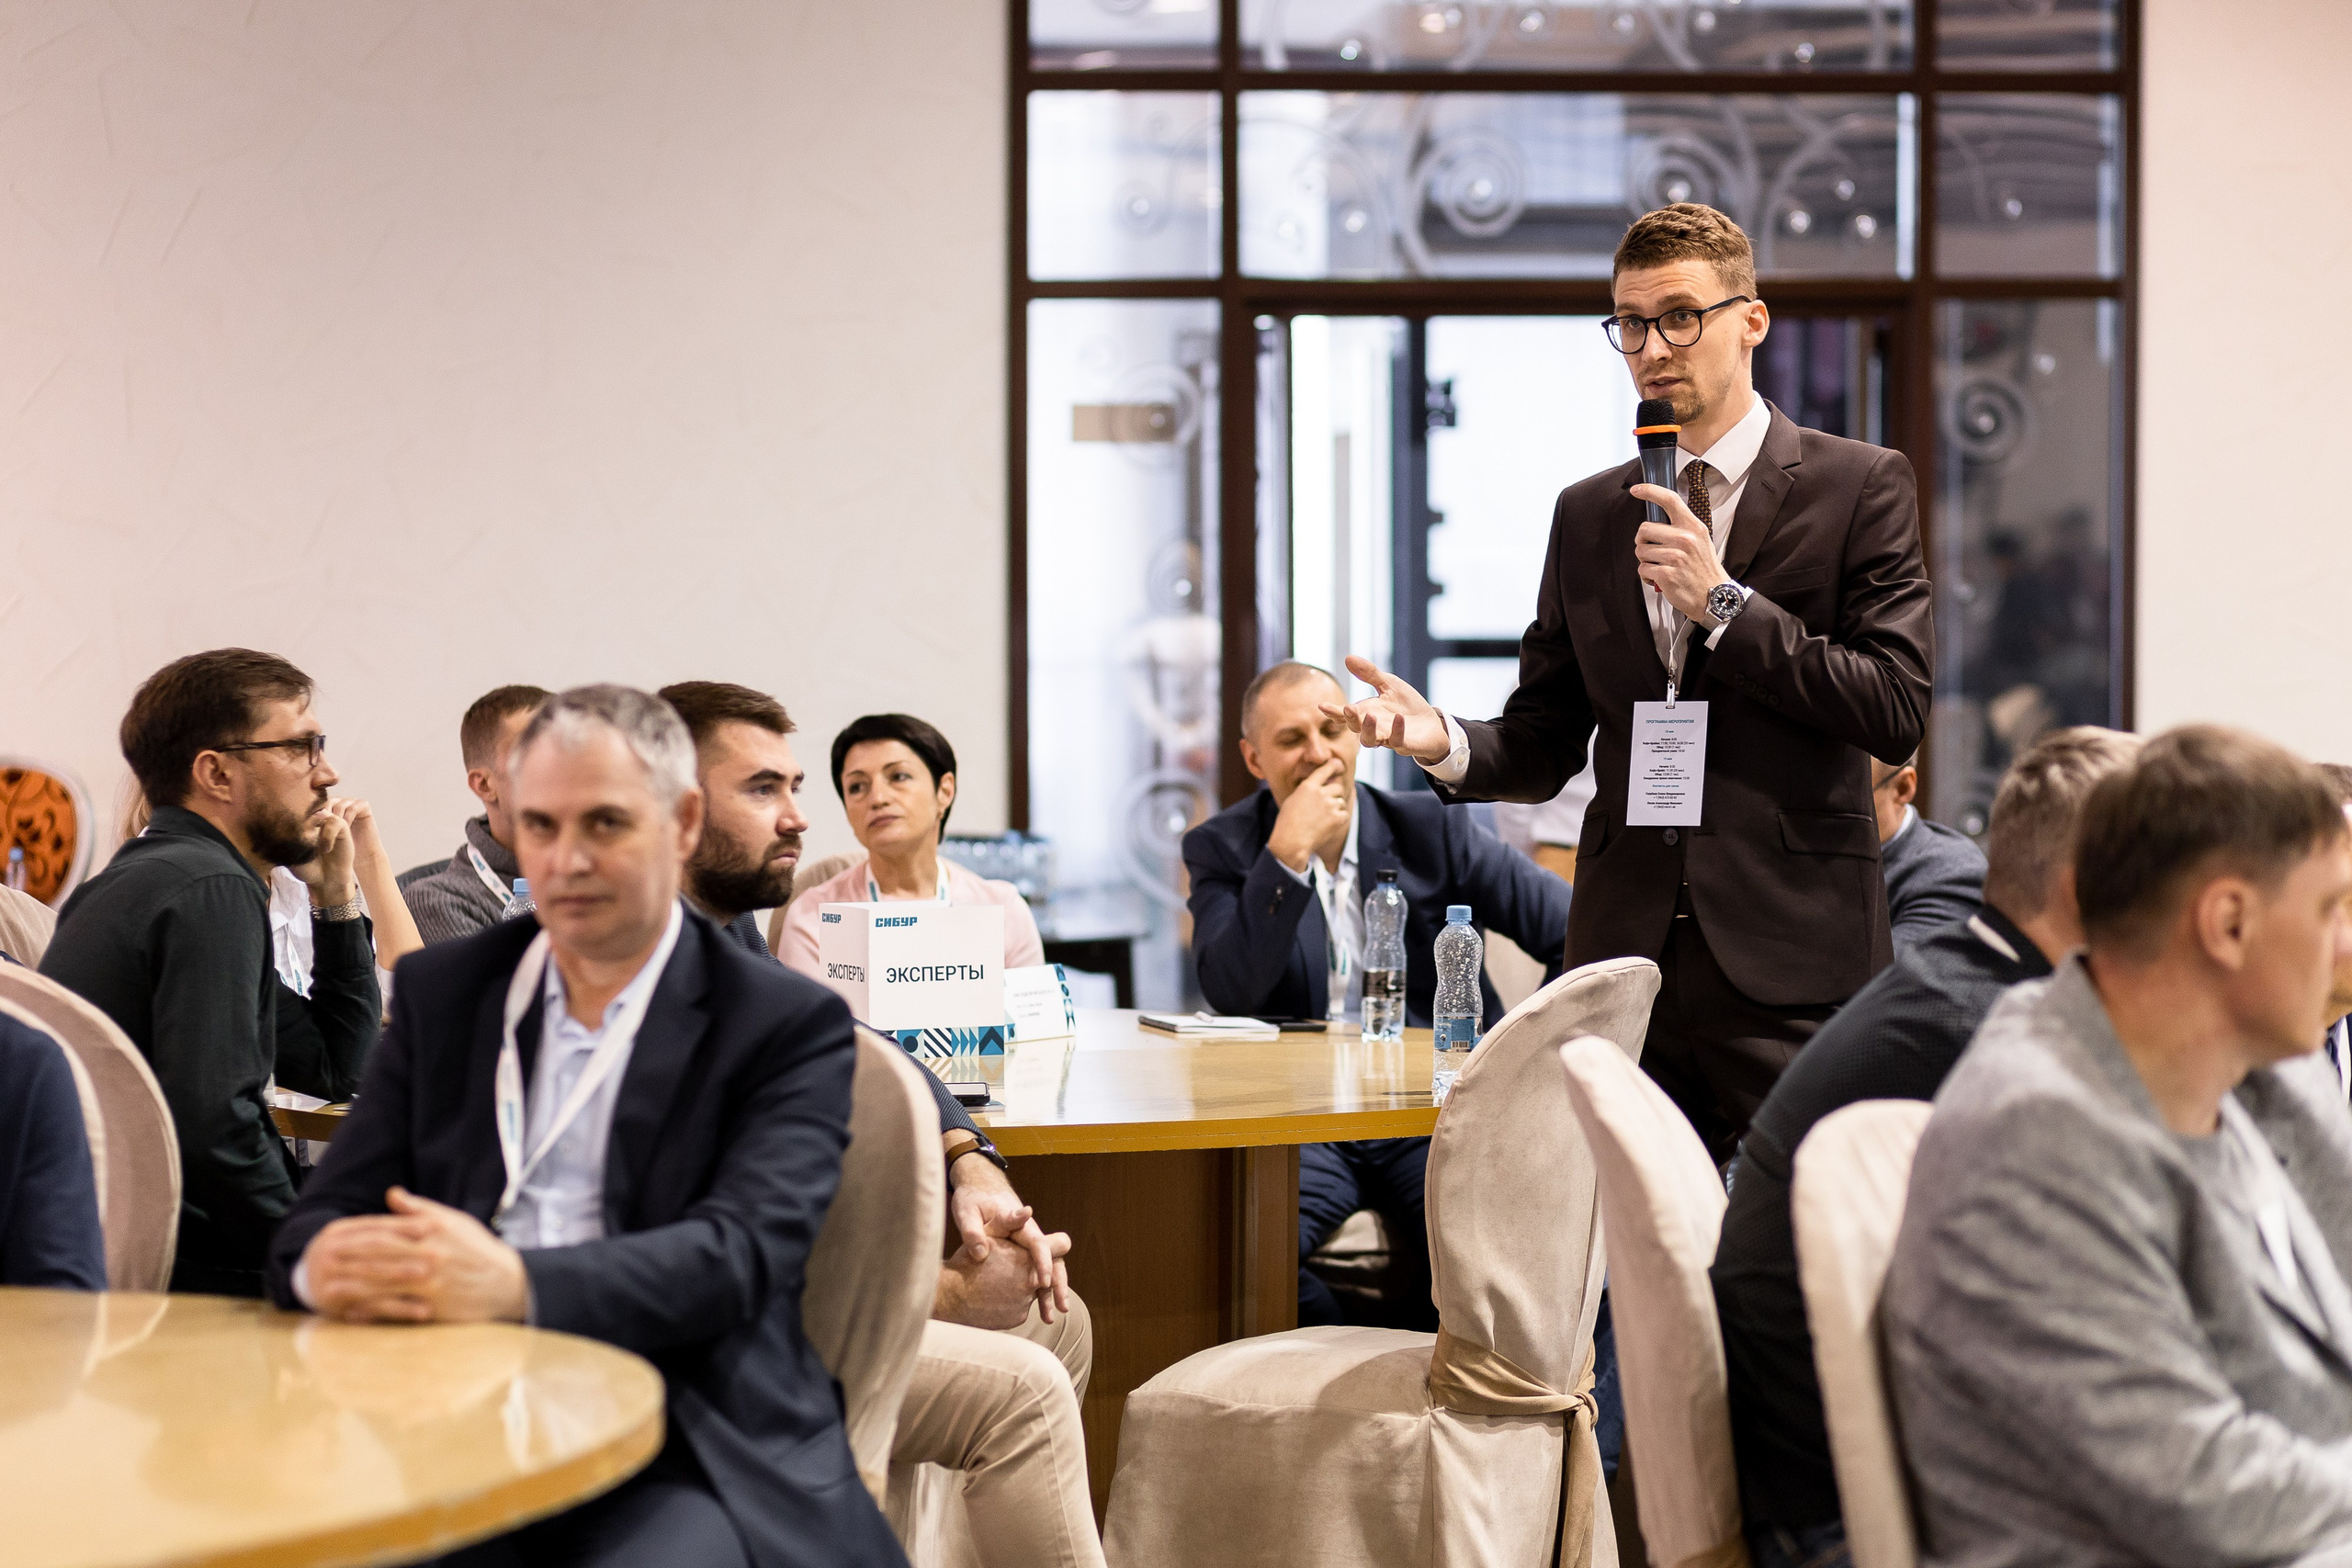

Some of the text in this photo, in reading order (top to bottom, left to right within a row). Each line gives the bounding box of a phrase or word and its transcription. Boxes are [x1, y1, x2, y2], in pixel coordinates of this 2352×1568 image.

[821, 912, 842, 924] СИБУР
[875, 916, 918, 928] СИБУР
[827, 963, 865, 983] ЭКСПЕРТЫ
[886, 964, 984, 984] ЭКСПЕРТЫ
